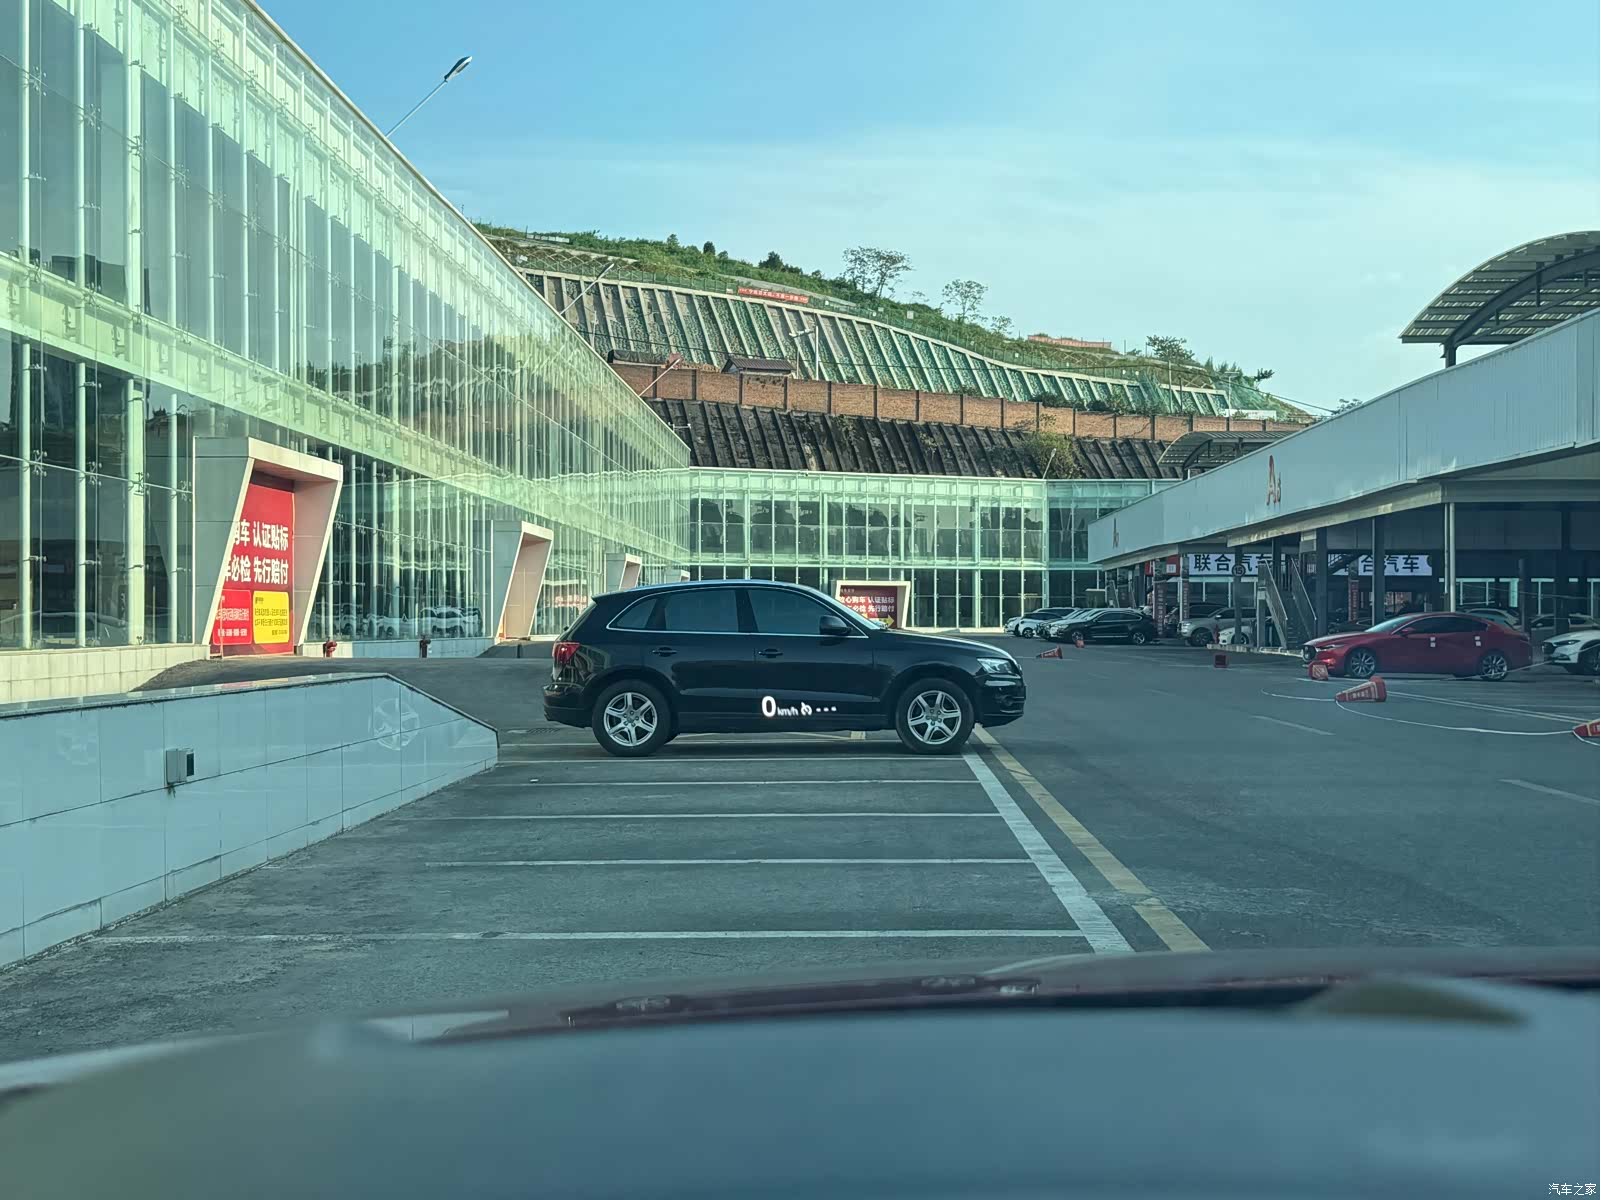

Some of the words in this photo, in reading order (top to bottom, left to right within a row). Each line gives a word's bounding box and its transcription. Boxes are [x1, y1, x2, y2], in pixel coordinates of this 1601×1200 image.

[253, 521, 289, 551] 认证贴标
[253, 556, 289, 584] 先行赔付
[1235, 567, 1243, 575] 15
[761, 695, 776, 718] 0
[777, 706, 799, 717] km/h
